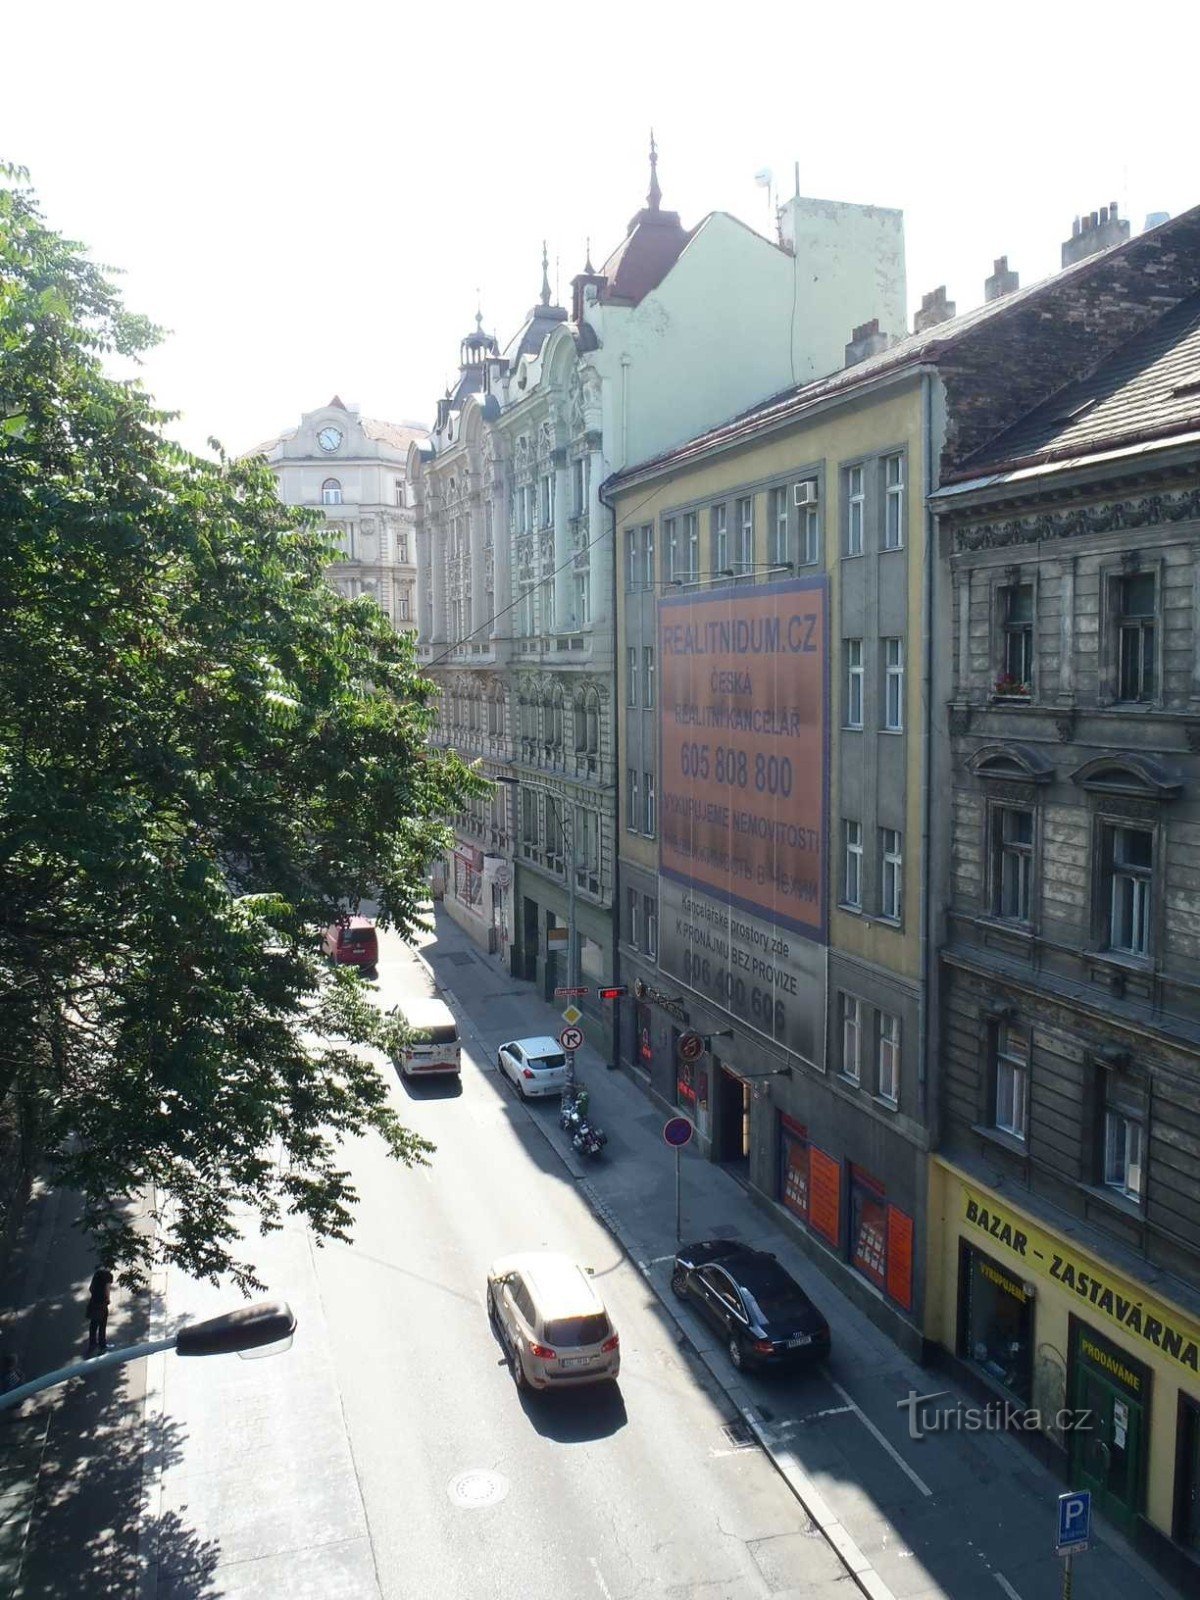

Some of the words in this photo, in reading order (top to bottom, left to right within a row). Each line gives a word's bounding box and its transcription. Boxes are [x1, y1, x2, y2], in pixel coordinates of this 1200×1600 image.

[680, 741, 710, 780] 605
[715, 745, 748, 788] 808
[754, 751, 793, 799] 800
[731, 946, 750, 972] BEZ
[751, 956, 799, 997] PROVIZE
[771, 936, 790, 958] zde
[966, 1199, 1028, 1257] BAZAR
[1048, 1253, 1199, 1373] ZASTAVÁRNA
[1064, 1499, 1084, 1529] P
